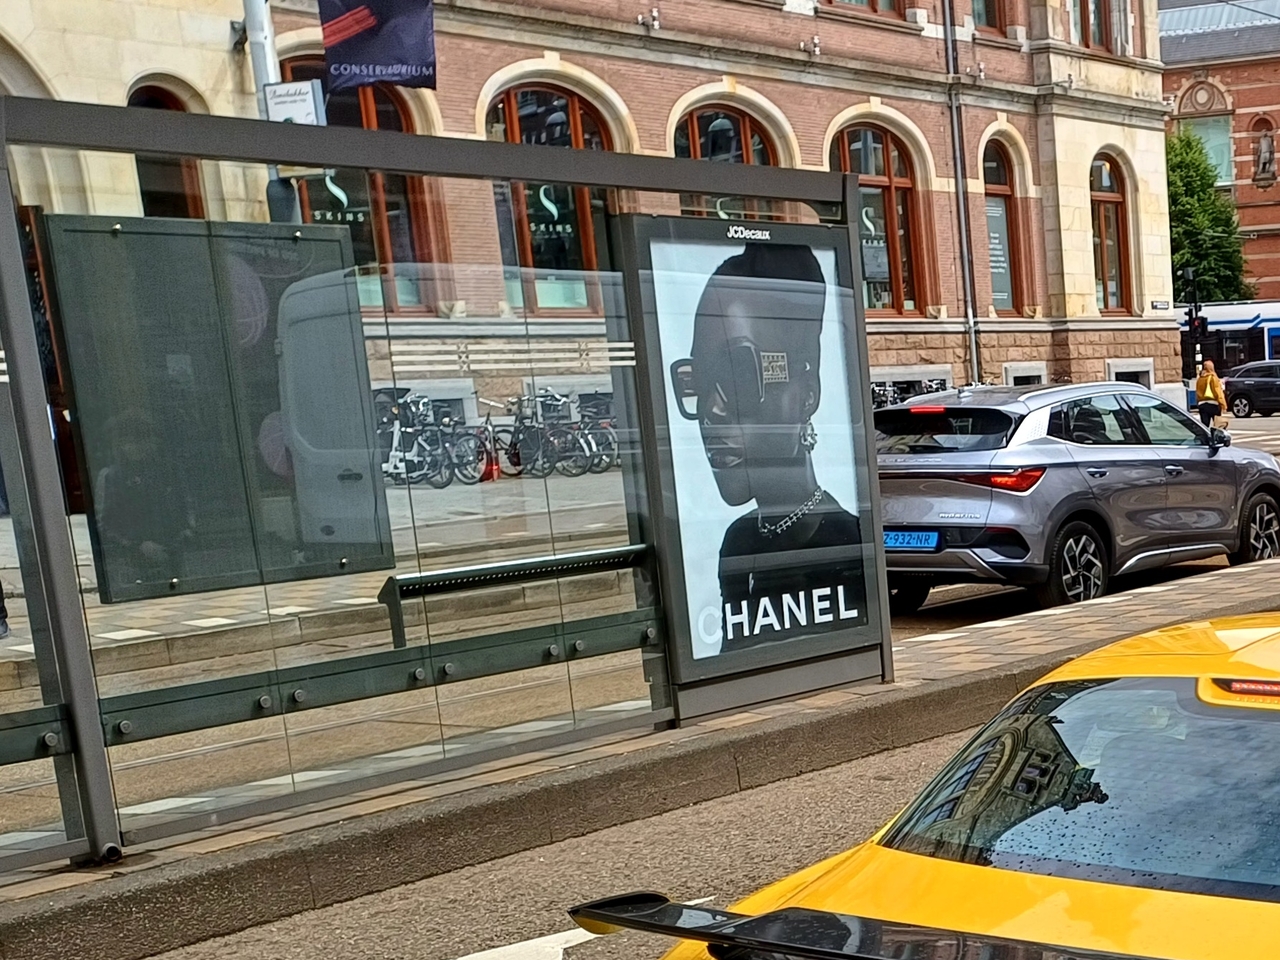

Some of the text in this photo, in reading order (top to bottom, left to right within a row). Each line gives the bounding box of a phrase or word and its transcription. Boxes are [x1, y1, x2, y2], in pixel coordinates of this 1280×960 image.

[314, 211, 365, 222] SKINS
[529, 222, 573, 233] SKINS
[727, 225, 771, 240] JCDecaux
[697, 585, 859, 644] CHANEL
